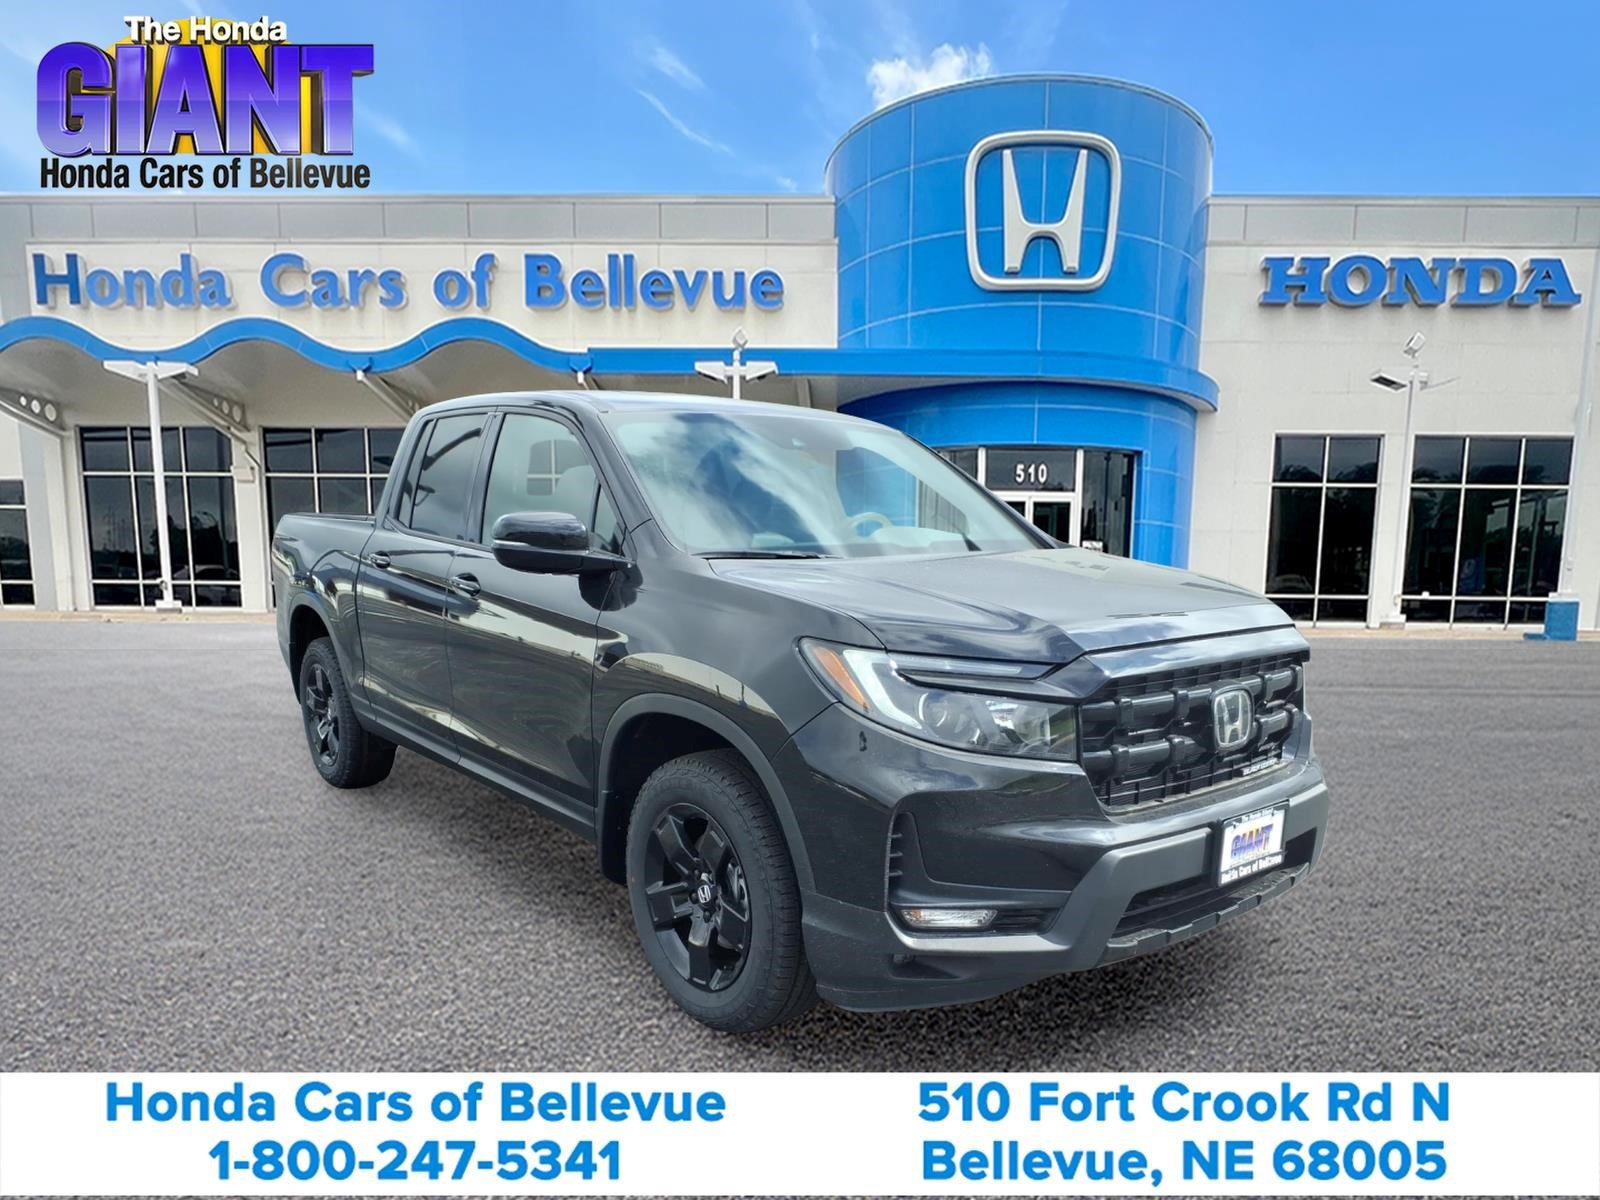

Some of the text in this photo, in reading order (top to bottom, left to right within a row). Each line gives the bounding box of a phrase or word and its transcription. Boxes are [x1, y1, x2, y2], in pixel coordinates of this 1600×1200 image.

[34, 253, 784, 310] Honda Cars of Bellevue
[1260, 255, 1582, 307] HONDA
[1015, 463, 1048, 484] 510
